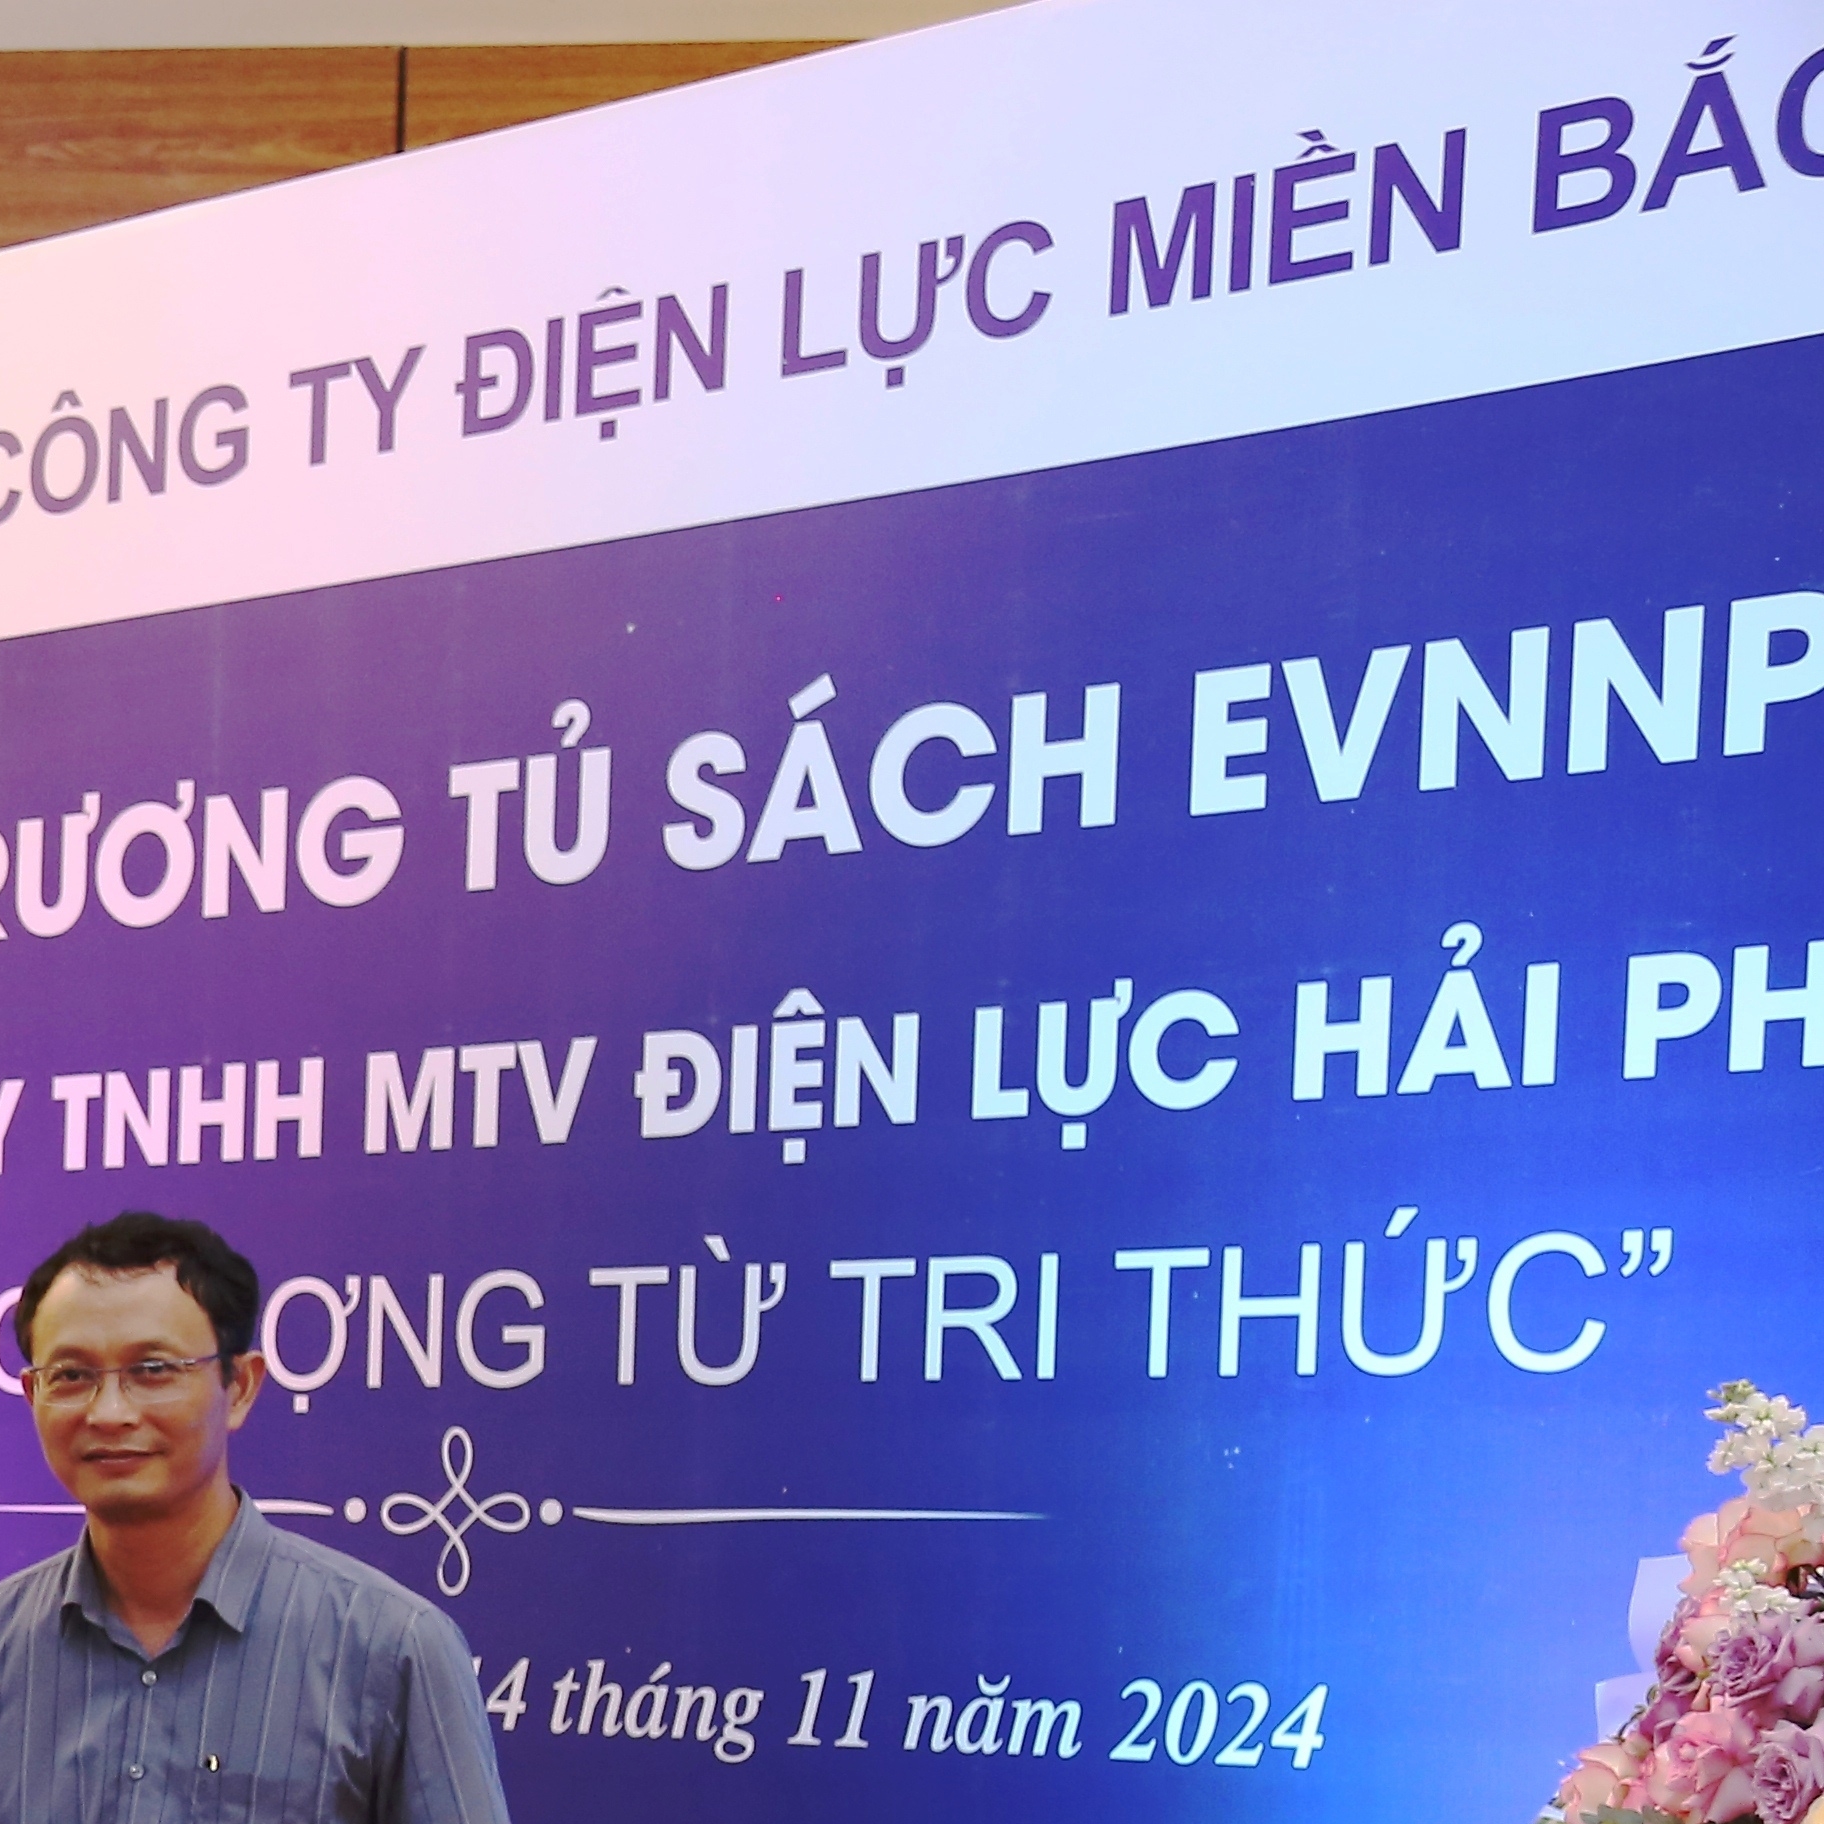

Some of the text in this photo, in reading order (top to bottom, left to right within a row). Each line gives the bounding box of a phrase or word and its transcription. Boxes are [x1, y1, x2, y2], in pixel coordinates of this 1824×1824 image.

[287, 343, 427, 468] TY
[454, 284, 731, 442] ĐIỆN
[778, 216, 1056, 388] LỰC
[1107, 126, 1469, 319] MIỀN
[449, 698, 612, 893] TỦ
[662, 673, 1122, 872] SÁCH
[50, 1055, 327, 1173] TNHH
[363, 1035, 599, 1157] MTV
[632, 986, 922, 1166] ĐIỆN
[970, 976, 1243, 1153] LỰC
[1291, 920, 1562, 1105] HẢI
[263, 1268, 547, 1415] ỢNG
[588, 1234, 788, 1388] TỪ
[830, 1250, 1061, 1384] TRI
[474, 1655, 1331, 1773] 4 tháng 11 năm 2024
